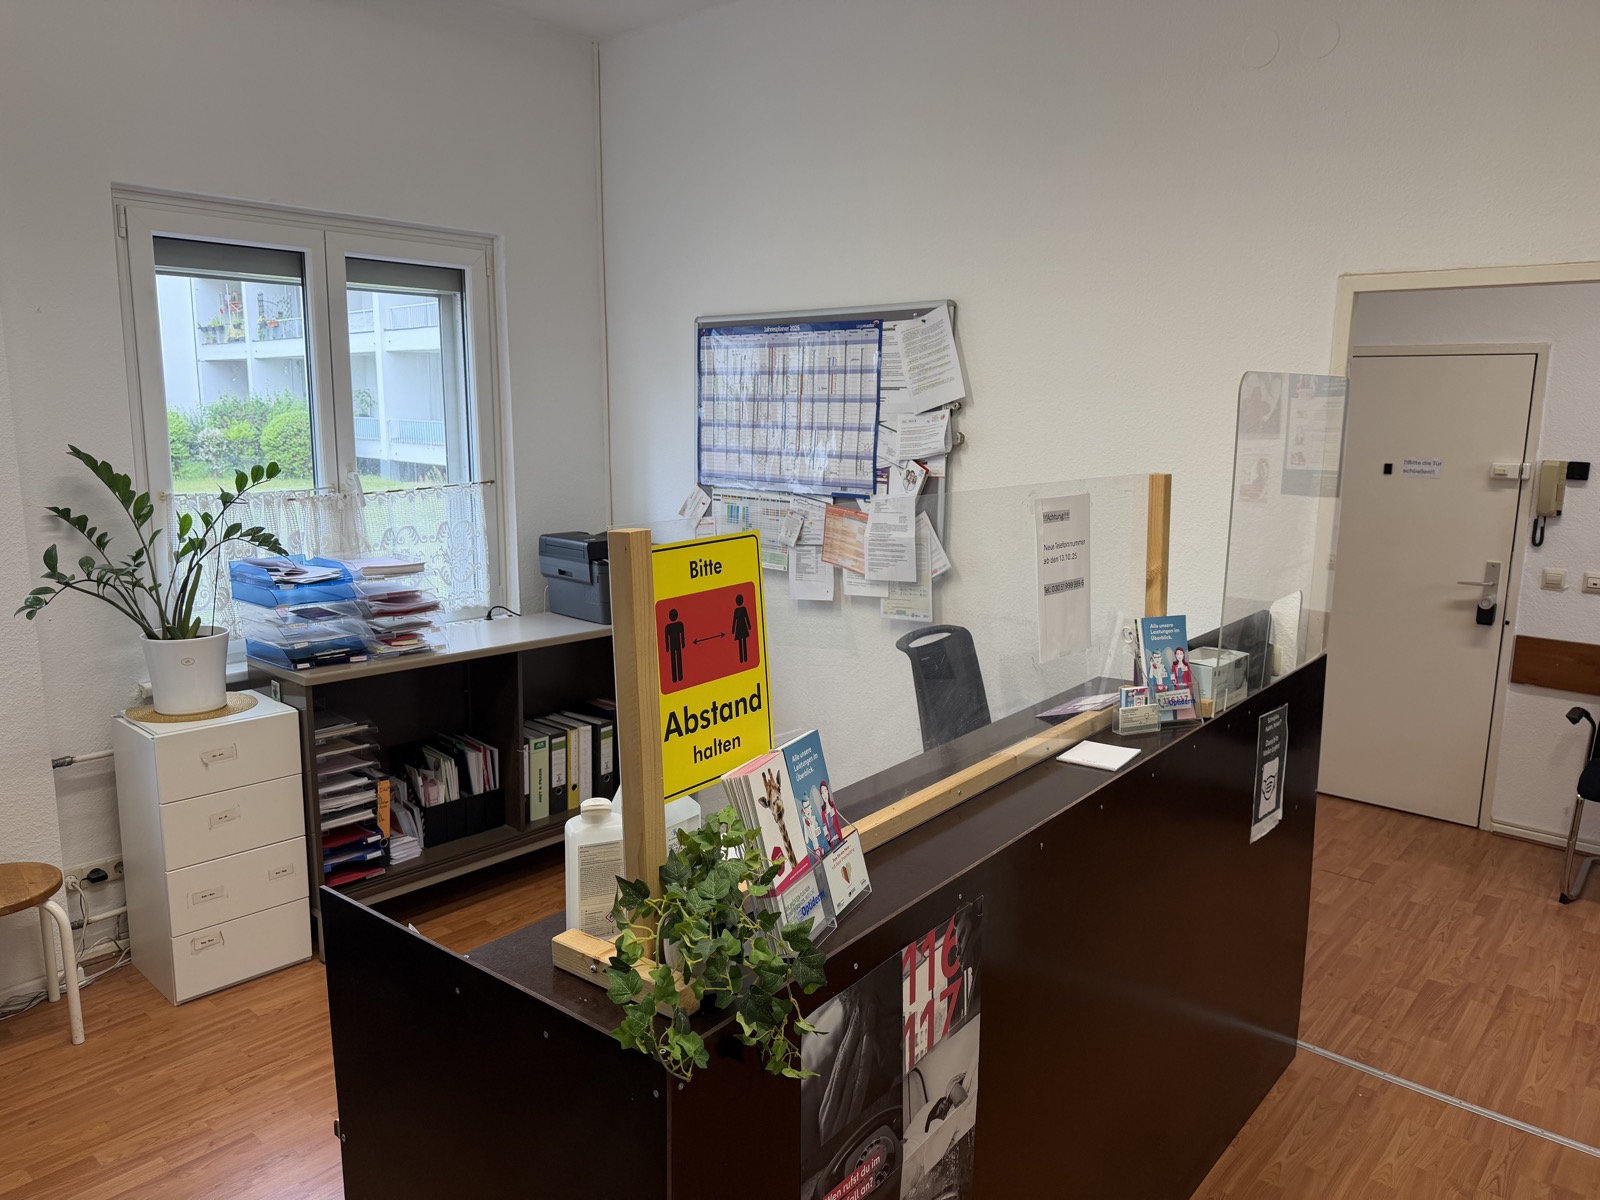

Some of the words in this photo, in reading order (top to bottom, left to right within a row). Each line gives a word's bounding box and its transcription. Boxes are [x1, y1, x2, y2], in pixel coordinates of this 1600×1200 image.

[1043, 543, 1055, 551] Neue
[1055, 539, 1085, 549] Telefonnummer
[689, 558, 723, 579] Bitte
[1043, 556, 1050, 565] ab
[1050, 555, 1059, 564] den
[663, 682, 763, 743] Abstand
[693, 734, 741, 764] halten
[800, 747, 812, 760] unsere
[793, 755, 814, 772] Leistungen
[796, 767, 815, 782] Überblick.
[801, 889, 825, 917] Optiderm
[902, 914, 961, 1005] 116
[903, 976, 963, 1070] 117
[843, 1171, 859, 1193] rufst
[860, 1165, 870, 1177] du
[871, 1156, 881, 1168] im
[860, 1177, 874, 1195] an?
